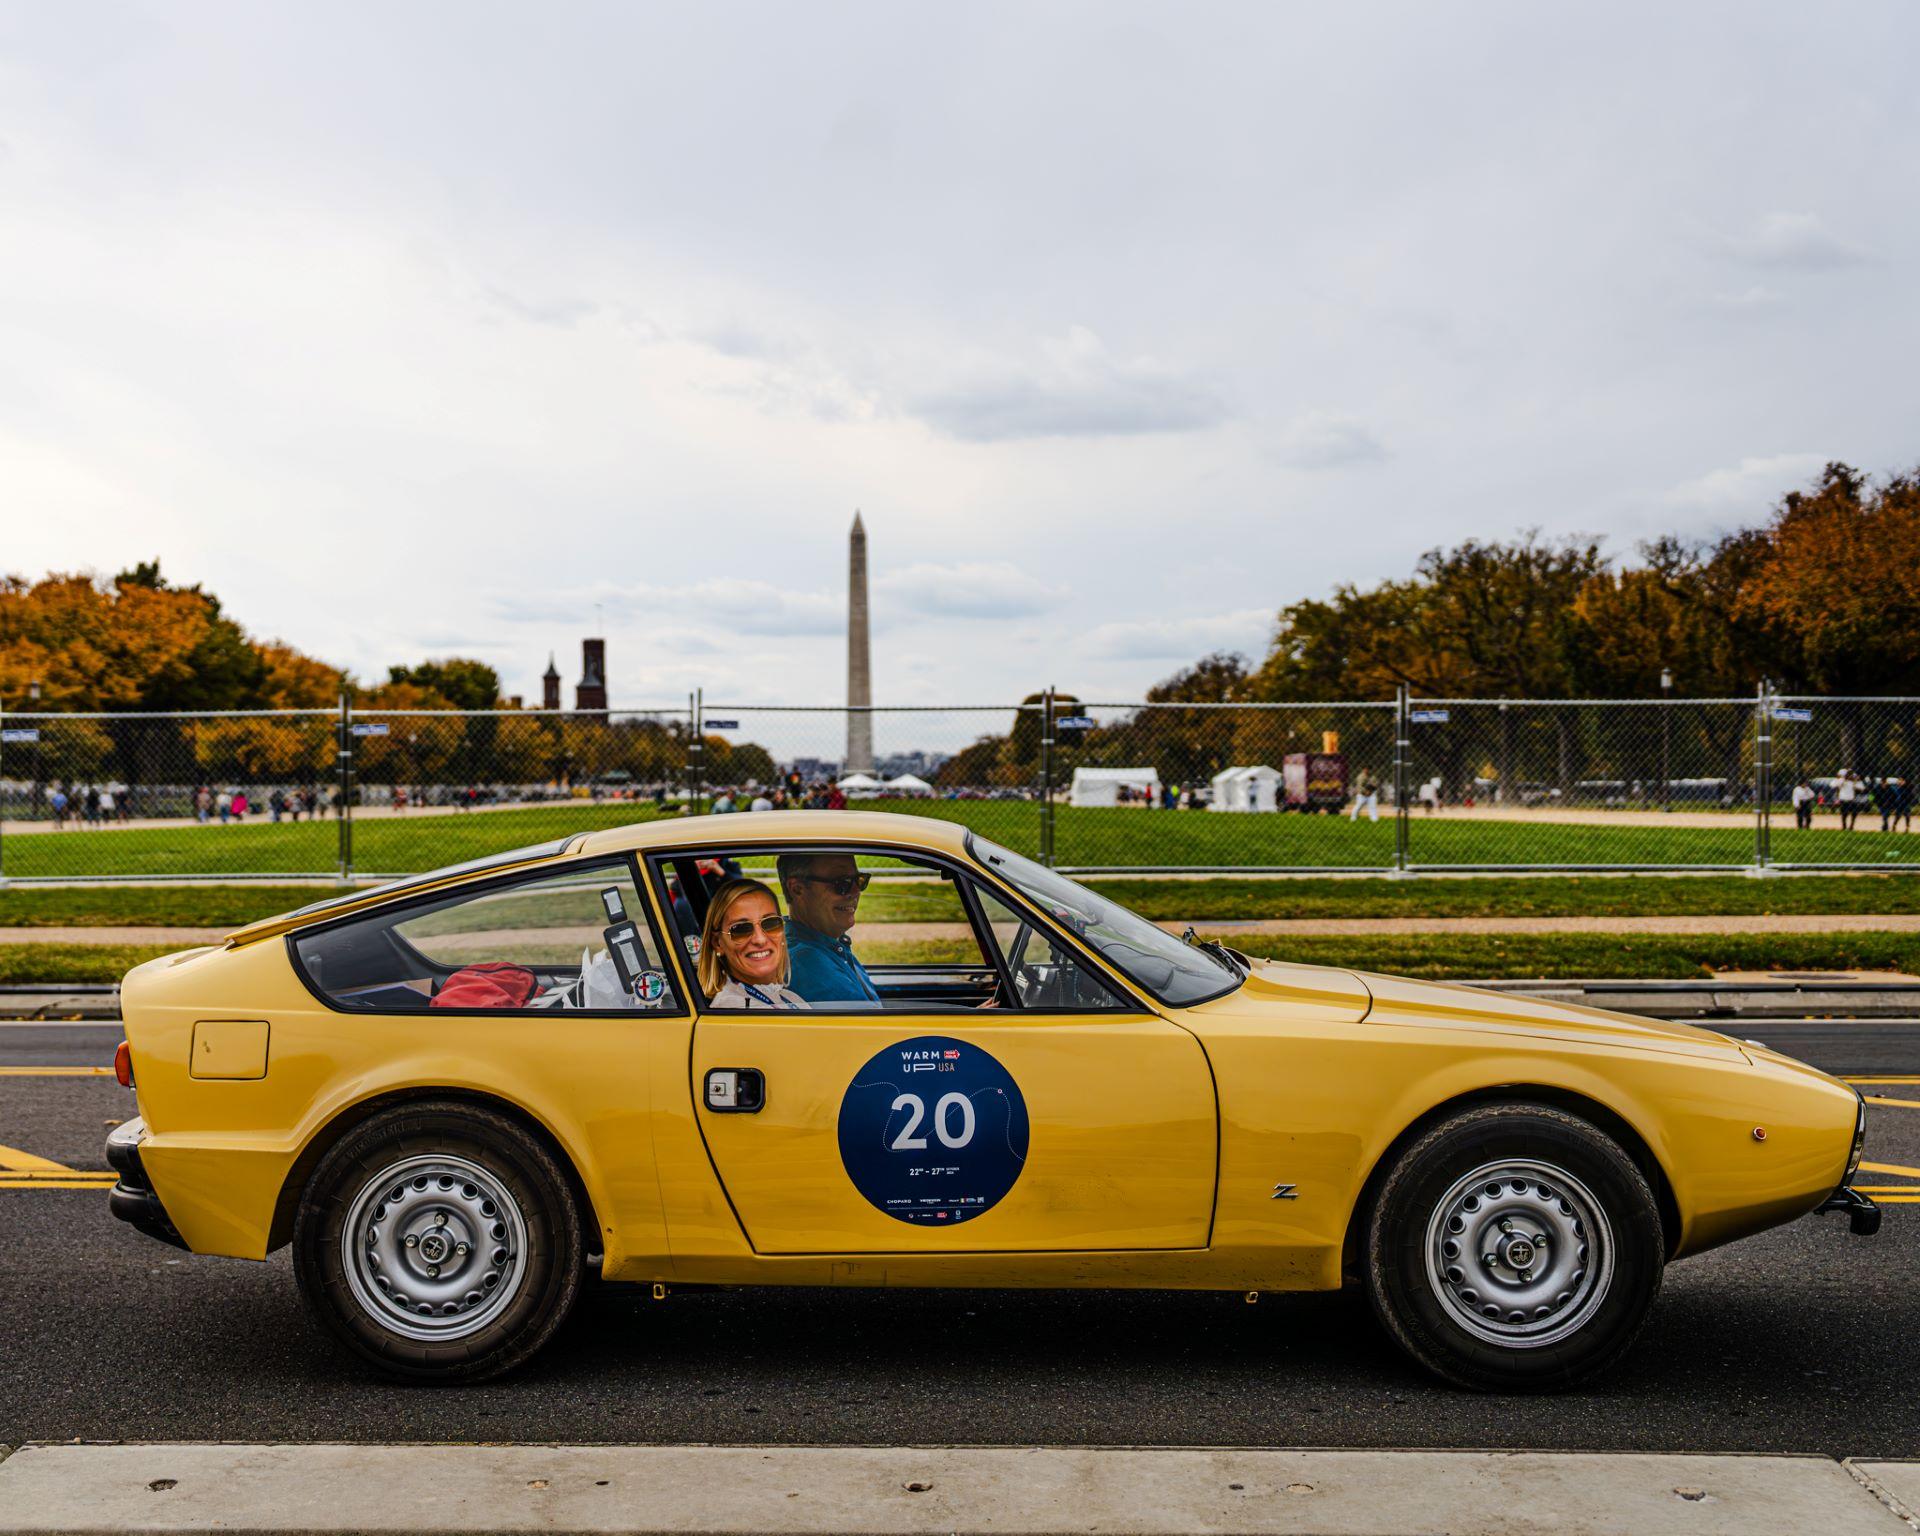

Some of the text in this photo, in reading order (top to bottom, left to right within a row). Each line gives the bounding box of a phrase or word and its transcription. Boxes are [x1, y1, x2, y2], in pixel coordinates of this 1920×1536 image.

[901, 1050, 940, 1060] WARM
[903, 1062, 955, 1073] UP USA
[891, 1091, 976, 1150] 20
